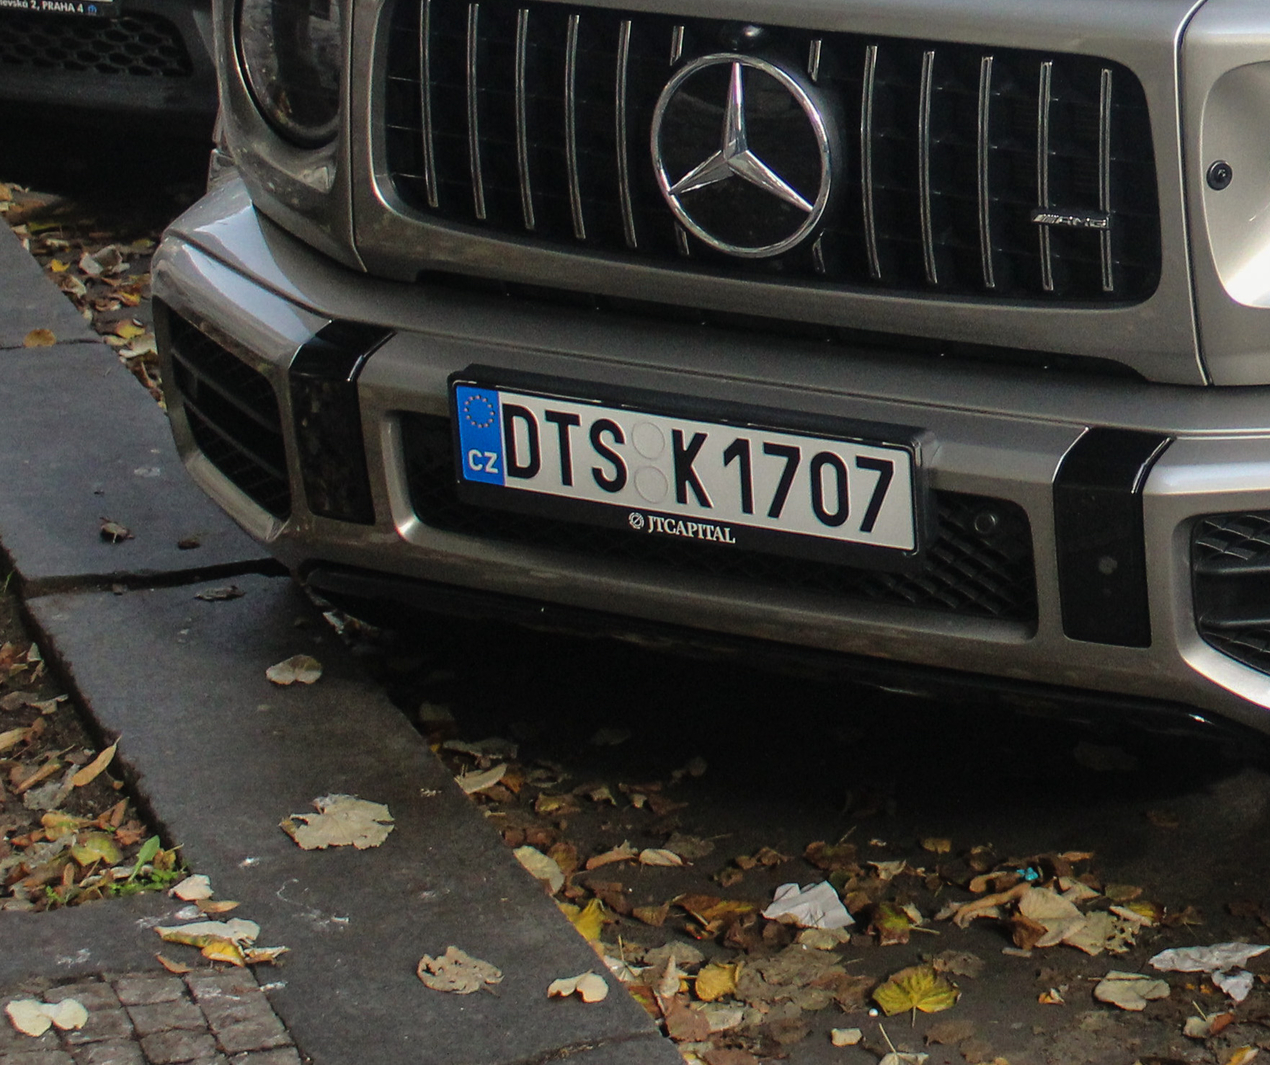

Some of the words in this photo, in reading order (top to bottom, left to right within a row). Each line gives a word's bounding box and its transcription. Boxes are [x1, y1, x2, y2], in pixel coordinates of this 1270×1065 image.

[42, 0, 75, 13] PRAHA
[77, 3, 84, 13] 4
[467, 448, 499, 474] CZ
[502, 402, 627, 494] DTS
[671, 428, 894, 533] K1707
[647, 514, 736, 544] JTCAPITAL
